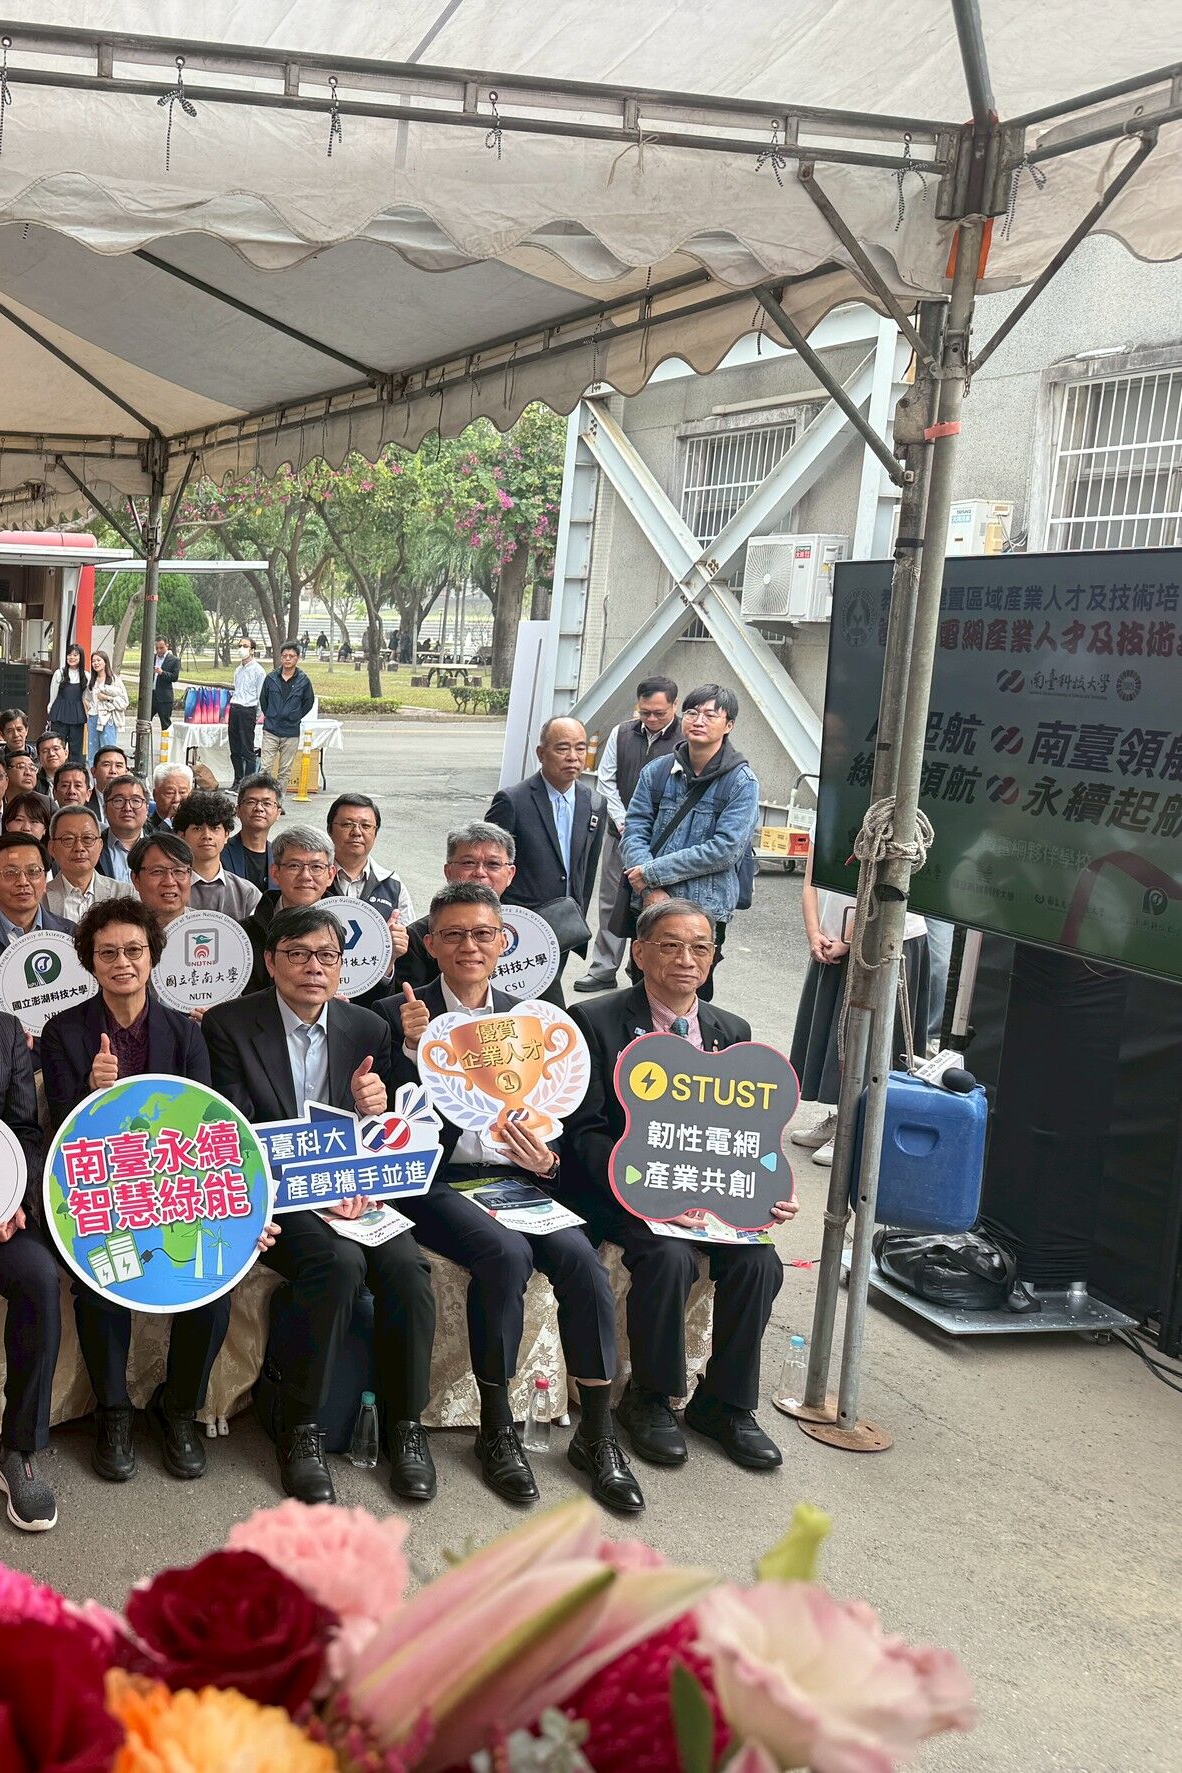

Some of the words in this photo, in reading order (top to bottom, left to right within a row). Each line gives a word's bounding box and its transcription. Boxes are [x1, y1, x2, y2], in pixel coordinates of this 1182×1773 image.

[1031, 668, 1110, 692] 南臺科技大學
[166, 967, 238, 988] 國立臺南大學
[504, 980, 526, 992] CSU
[12, 984, 88, 1011] 國立澎湖科技大學
[189, 992, 213, 1000] NUTN
[475, 1019, 518, 1044] 優質
[461, 1039, 543, 1070] 企業人才
[502, 1074, 515, 1090] 1
[671, 1073, 778, 1110] STUST
[61, 1121, 242, 1187] 南臺永續
[259, 1127, 347, 1161] 臺科大
[646, 1120, 761, 1159] 韌性電網
[286, 1161, 428, 1201] 產學攜手並進
[643, 1161, 756, 1199] 產業共創
[68, 1170, 252, 1237] 智慧綠能
